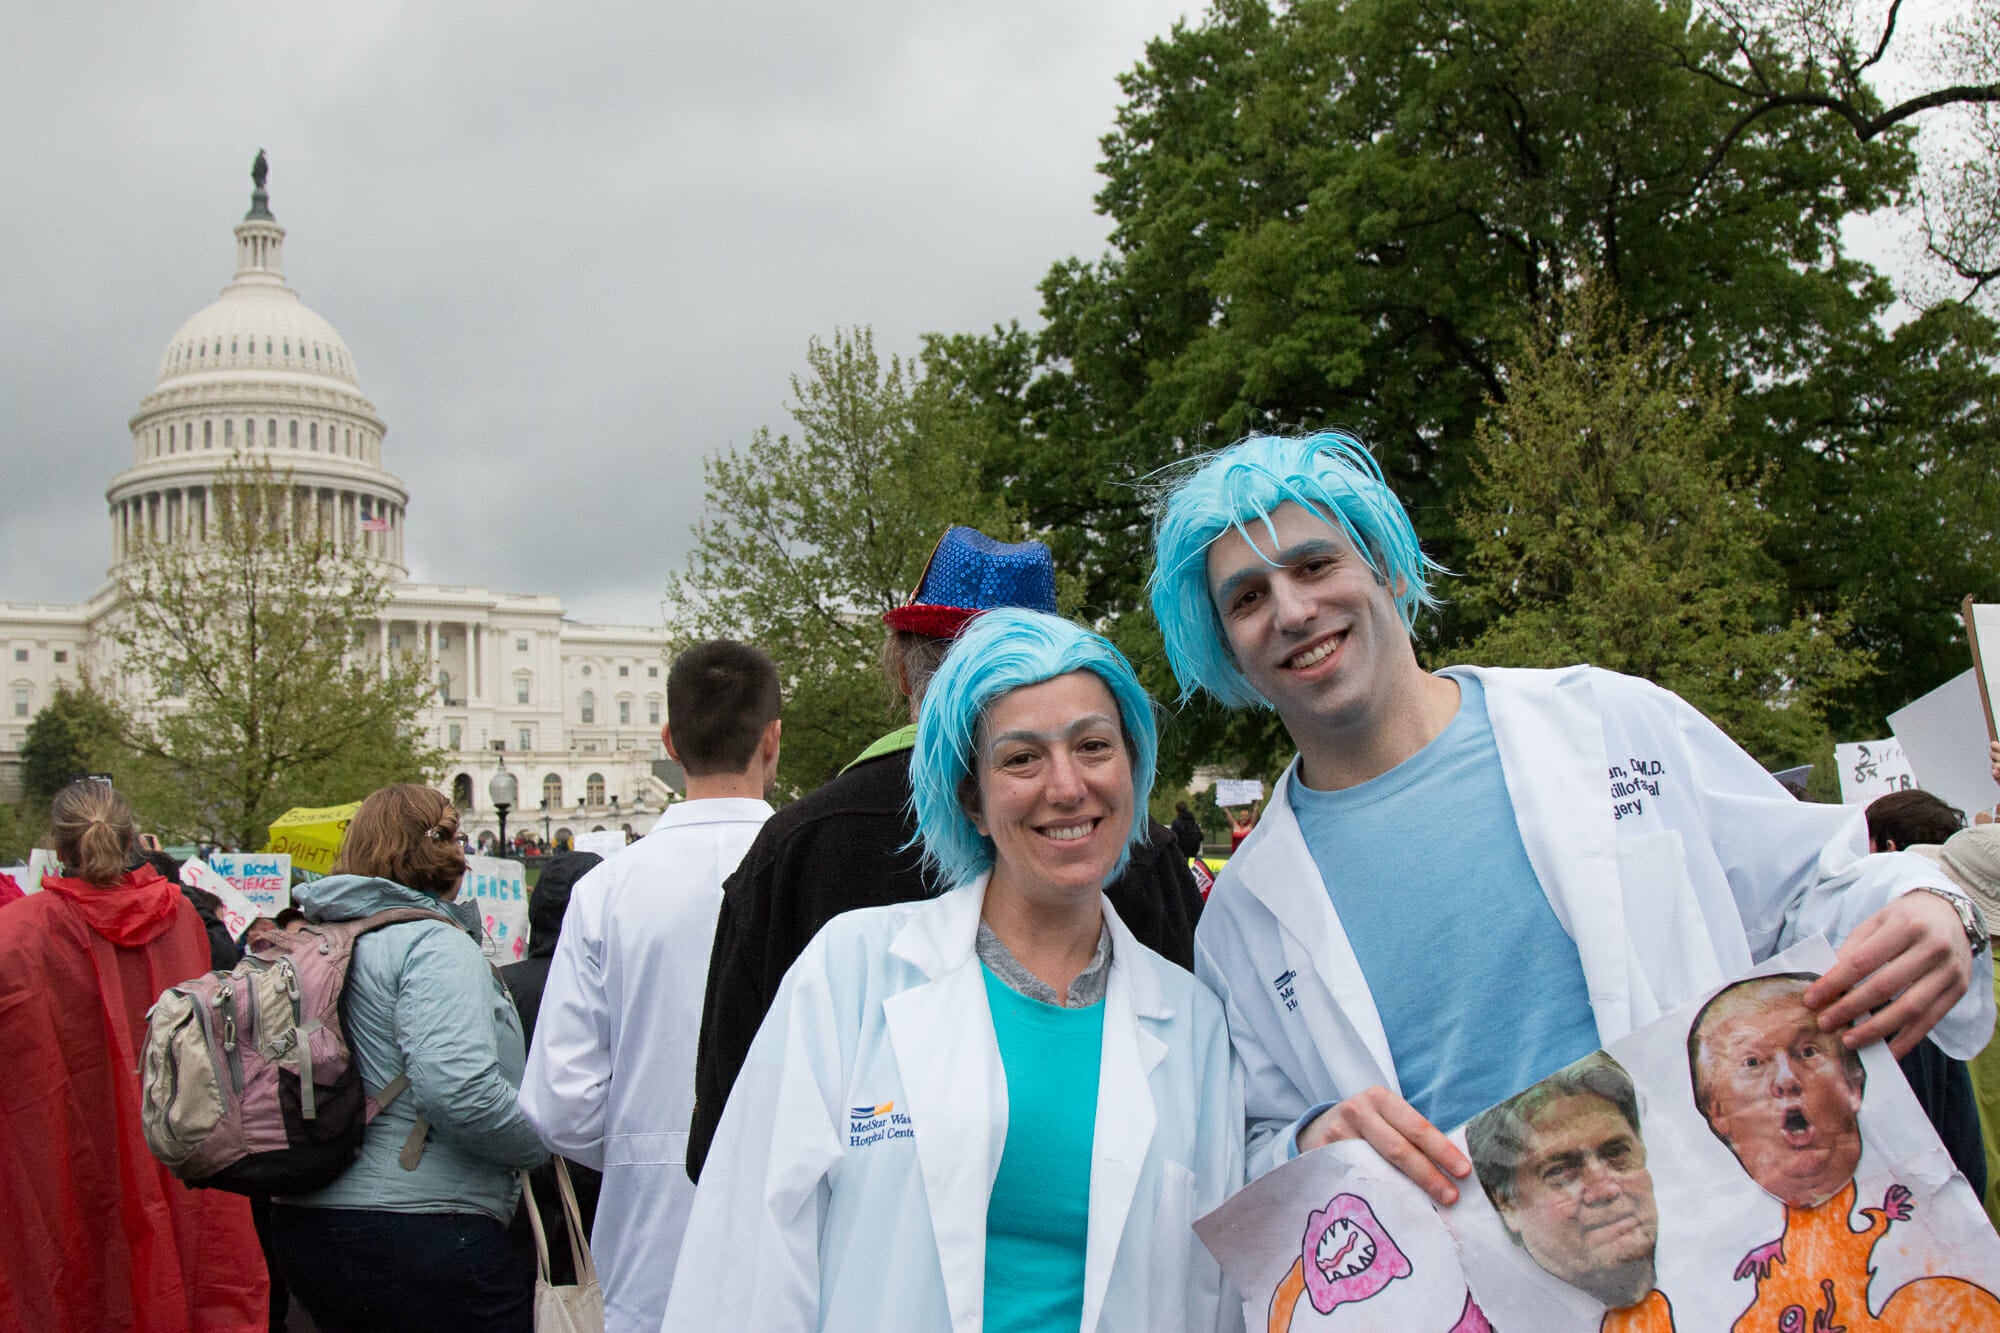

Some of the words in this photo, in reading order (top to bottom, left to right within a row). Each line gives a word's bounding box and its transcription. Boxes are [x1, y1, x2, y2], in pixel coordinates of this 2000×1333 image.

[462, 873, 522, 902] IENCE
[850, 1119, 888, 1134] MedStar
[849, 1128, 886, 1147] Hospital
[887, 1127, 915, 1140] Cente
